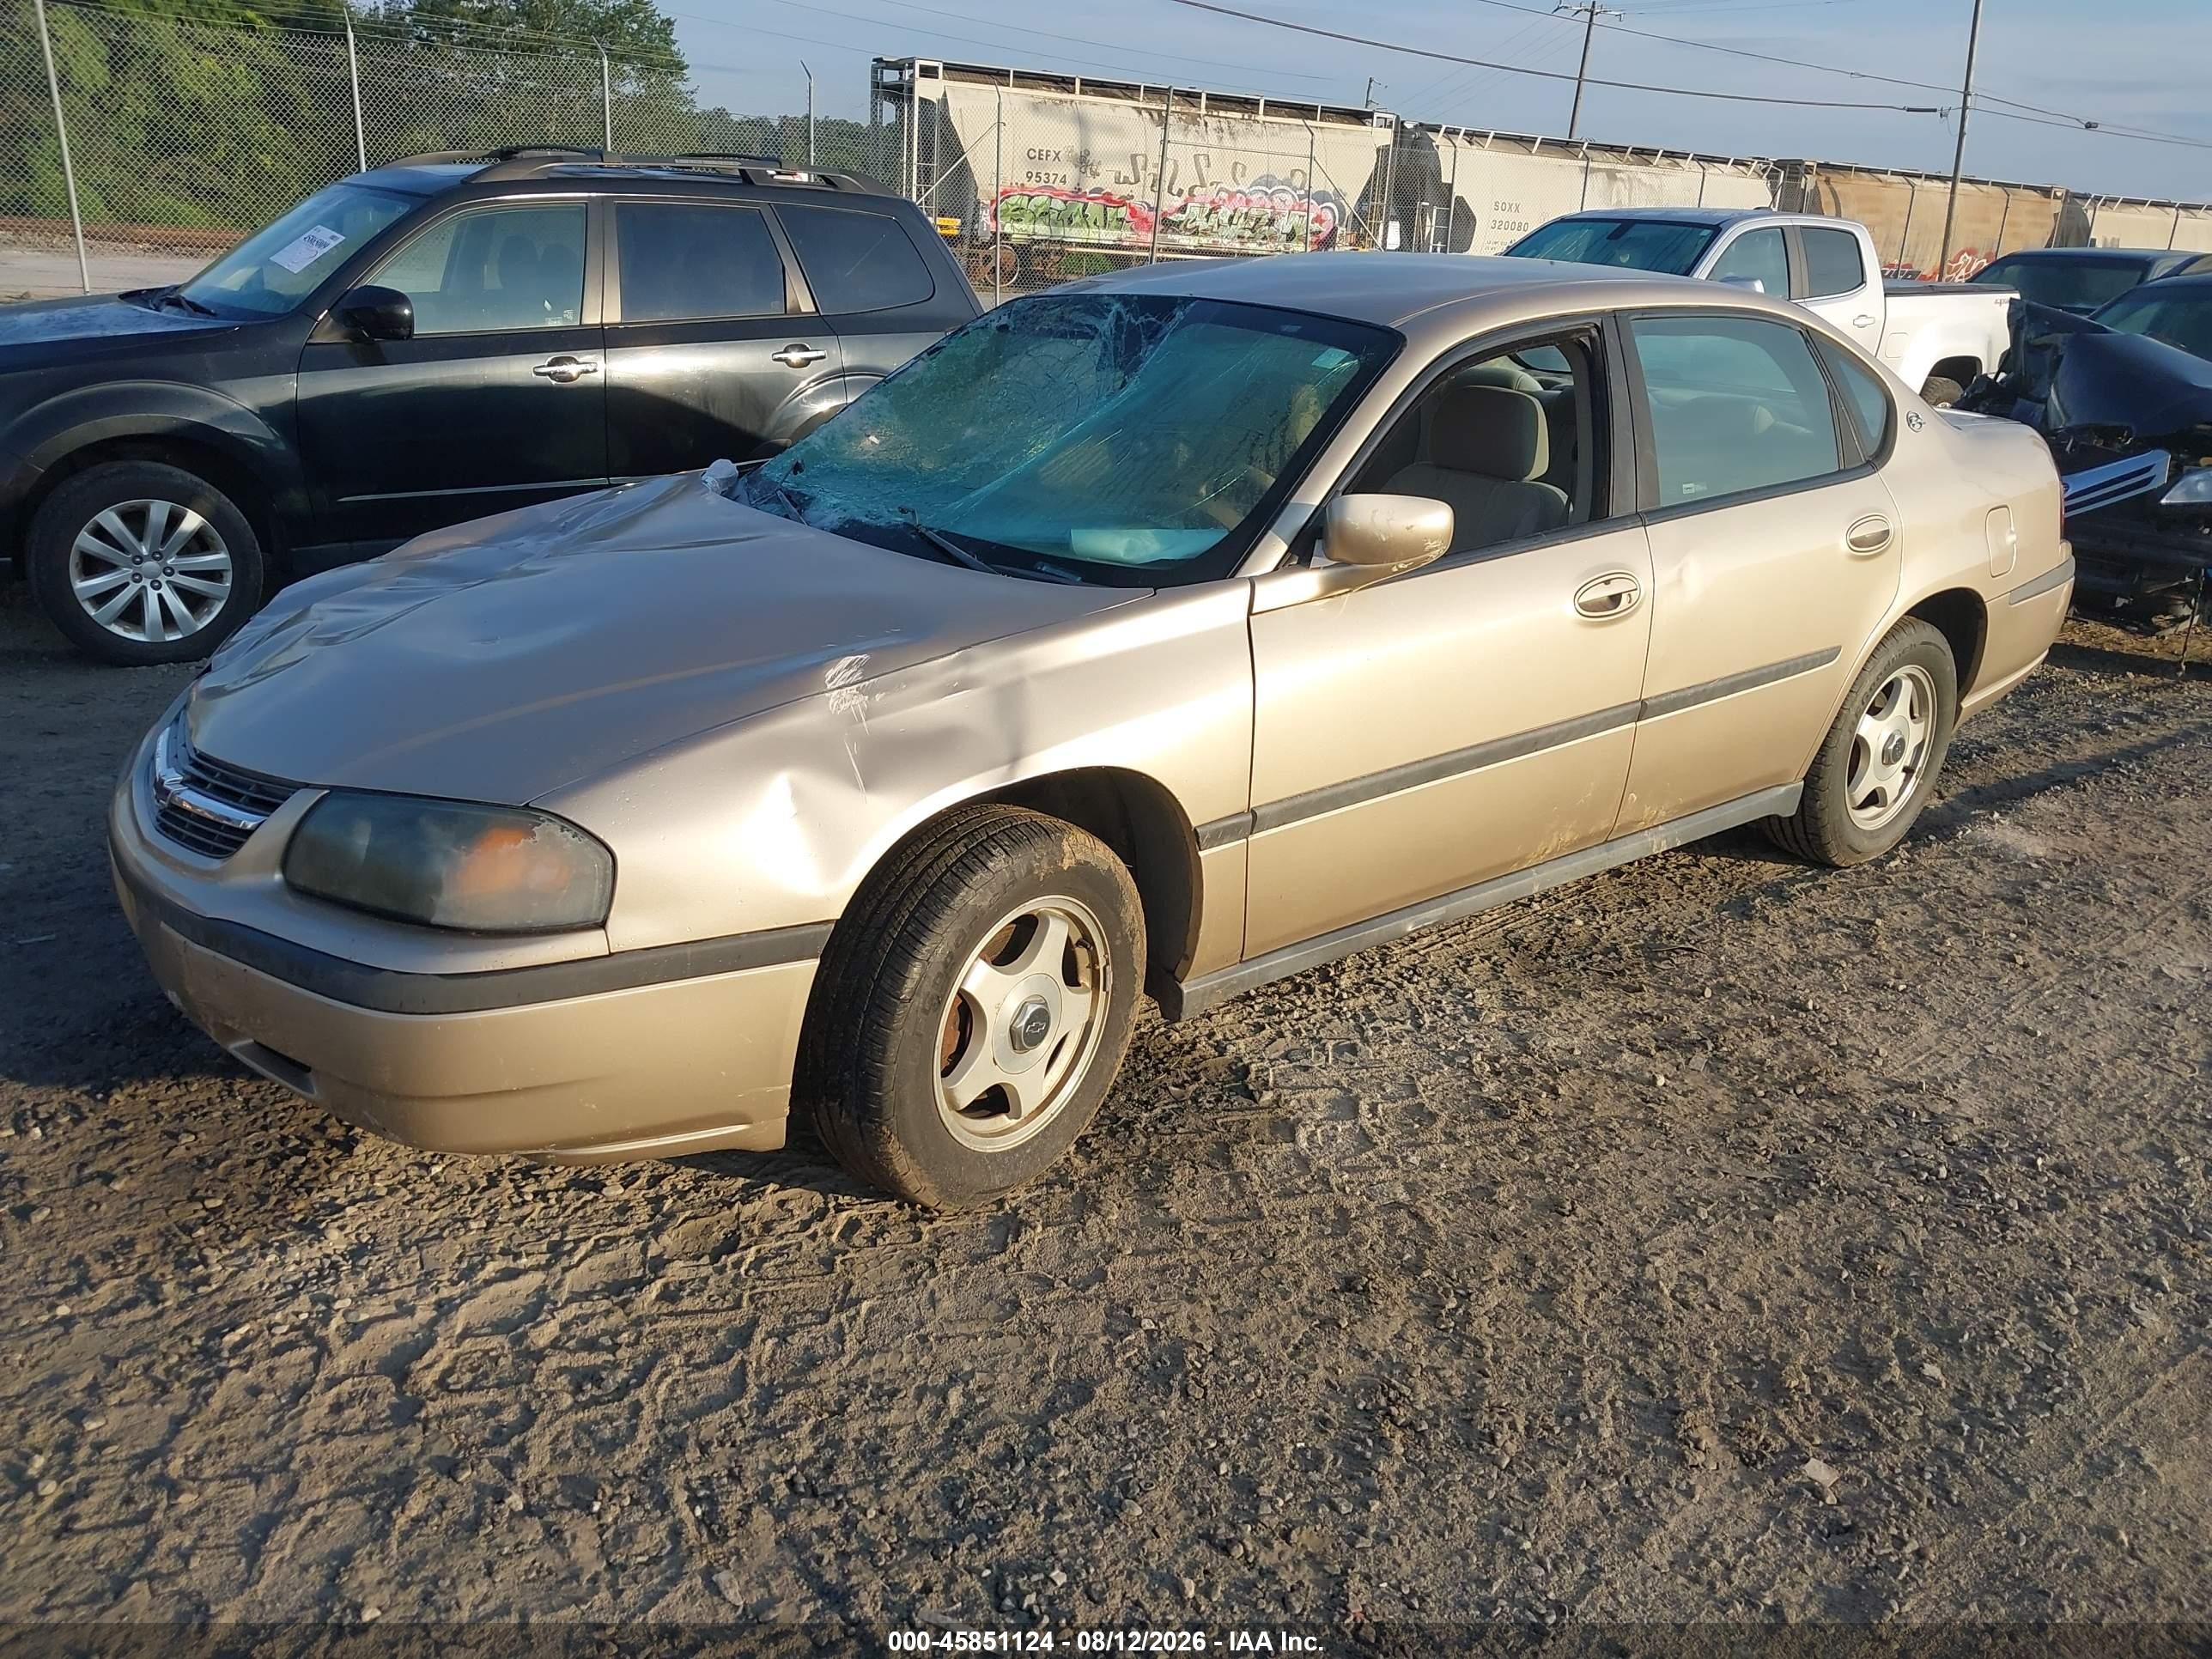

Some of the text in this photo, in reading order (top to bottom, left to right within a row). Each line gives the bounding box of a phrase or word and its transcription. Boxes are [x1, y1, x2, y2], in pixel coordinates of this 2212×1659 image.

[1026, 148, 1061, 162] CEFX
[1025, 170, 1067, 185] 95374
[1493, 200, 1521, 214] SOXX
[1490, 219, 1529, 233] 320080
